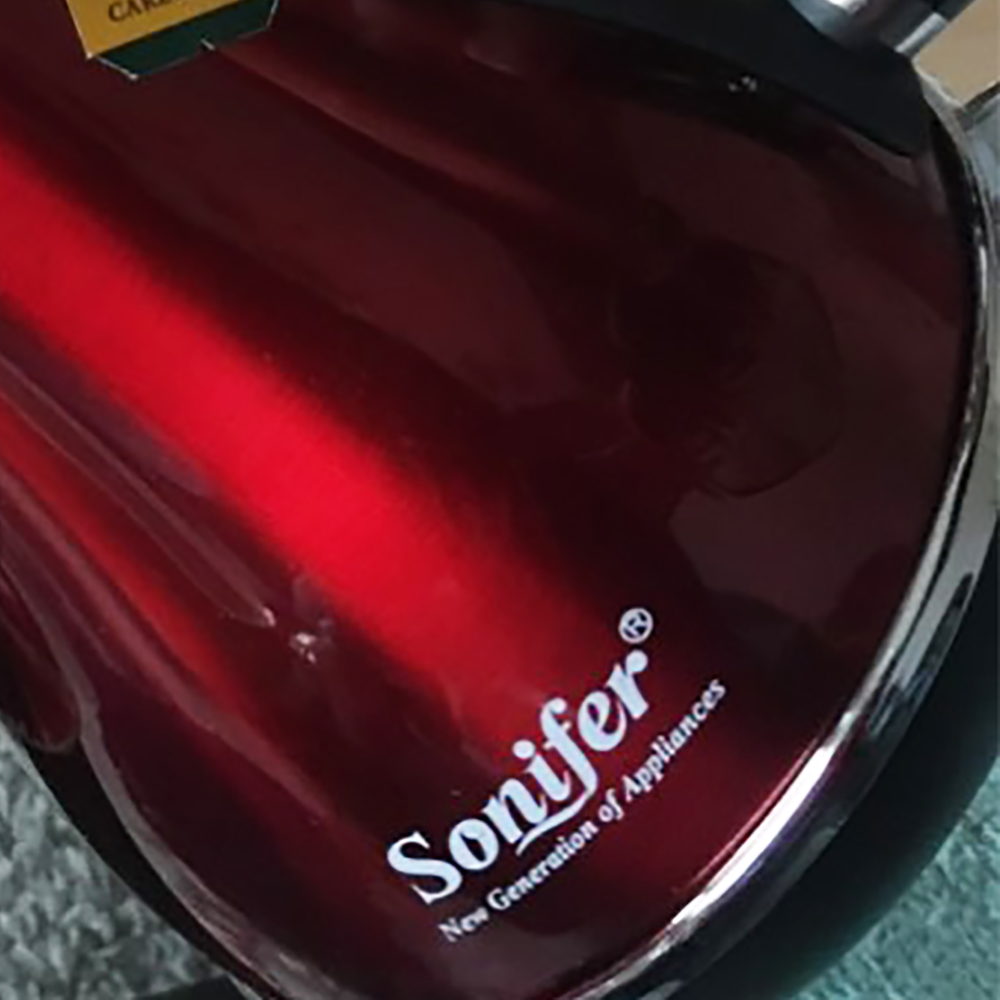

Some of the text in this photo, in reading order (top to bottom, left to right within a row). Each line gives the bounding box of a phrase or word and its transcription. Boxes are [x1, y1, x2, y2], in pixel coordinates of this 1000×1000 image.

[437, 677, 727, 943] New Generation of Appliances
